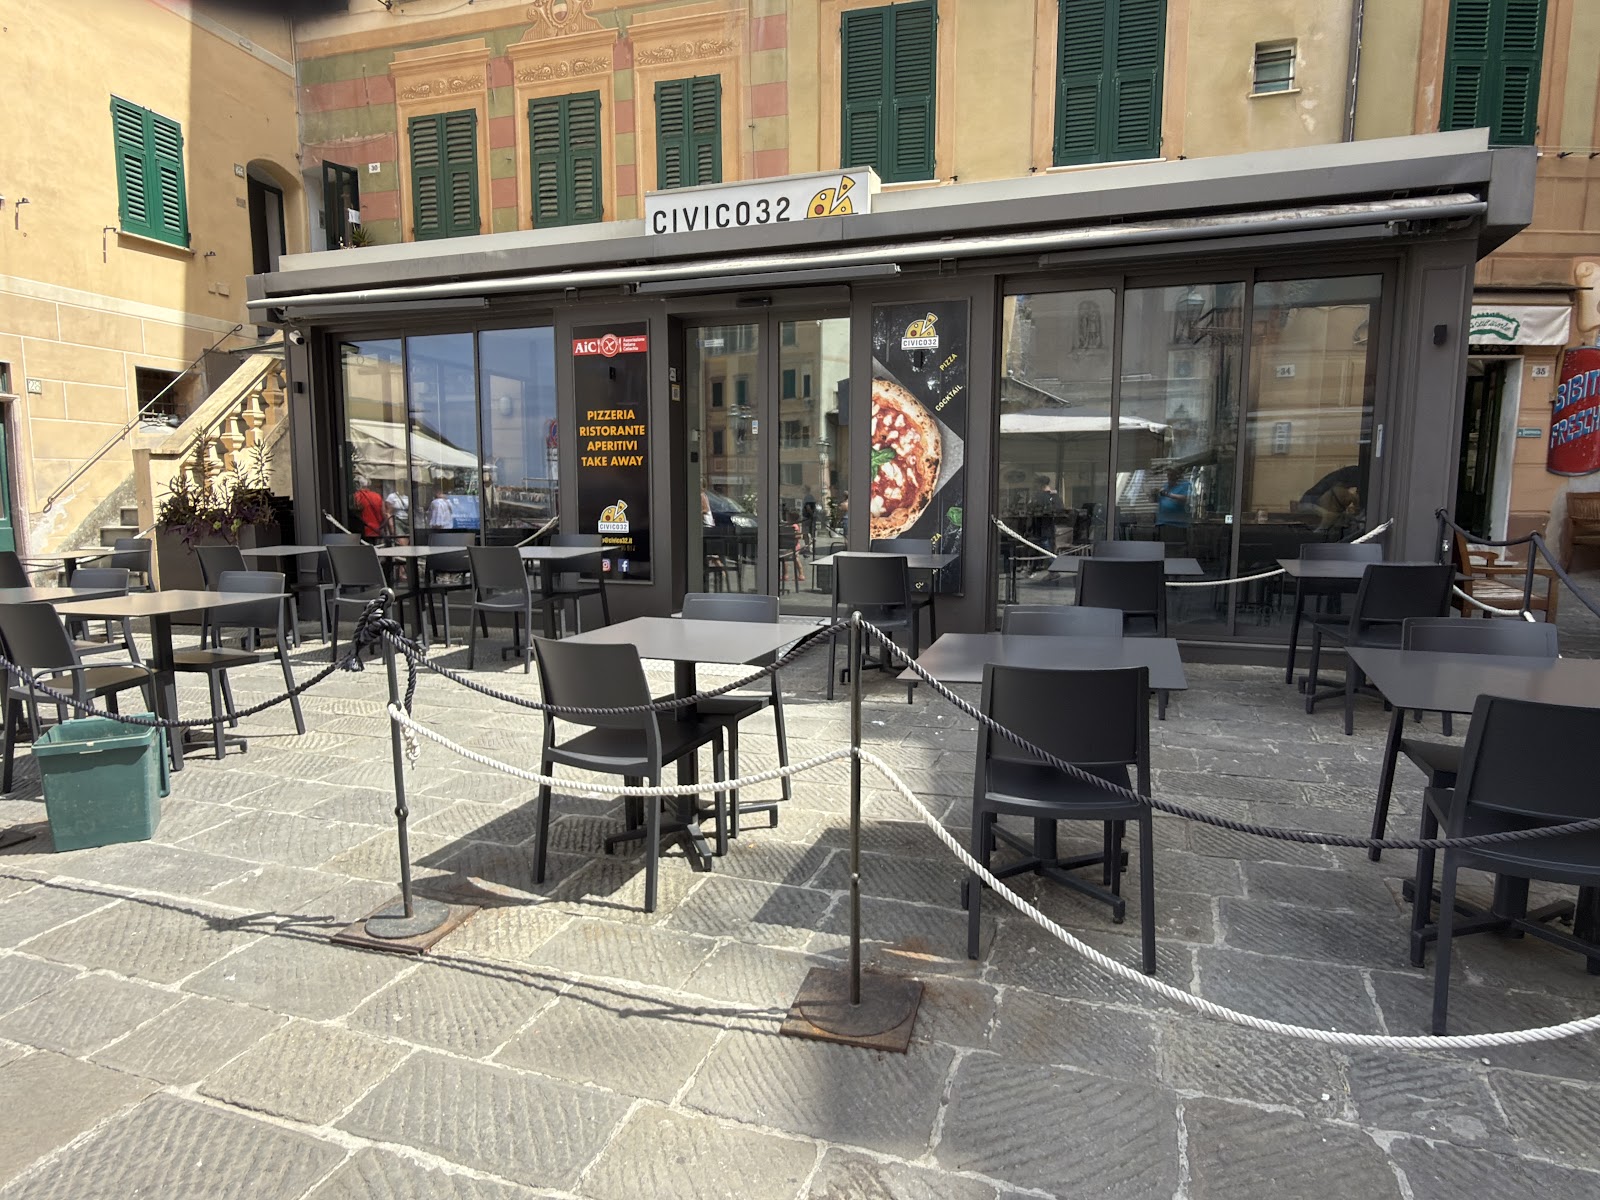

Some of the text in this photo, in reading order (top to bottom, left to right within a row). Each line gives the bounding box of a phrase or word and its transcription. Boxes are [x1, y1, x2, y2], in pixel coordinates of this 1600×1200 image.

[653, 197, 791, 234] CIVICO32
[575, 341, 597, 354] AiC
[903, 338, 937, 347] CIVICO32
[939, 353, 958, 371] PIZZA
[30, 380, 41, 391] 28
[1554, 368, 1600, 415] BIBIT
[935, 384, 963, 411] COCKTAIL
[587, 409, 635, 420] PIZZERIA
[579, 425, 646, 436] RISTORANTE
[587, 440, 638, 451] APERITIVI
[581, 456, 644, 467] TAKE AWAY
